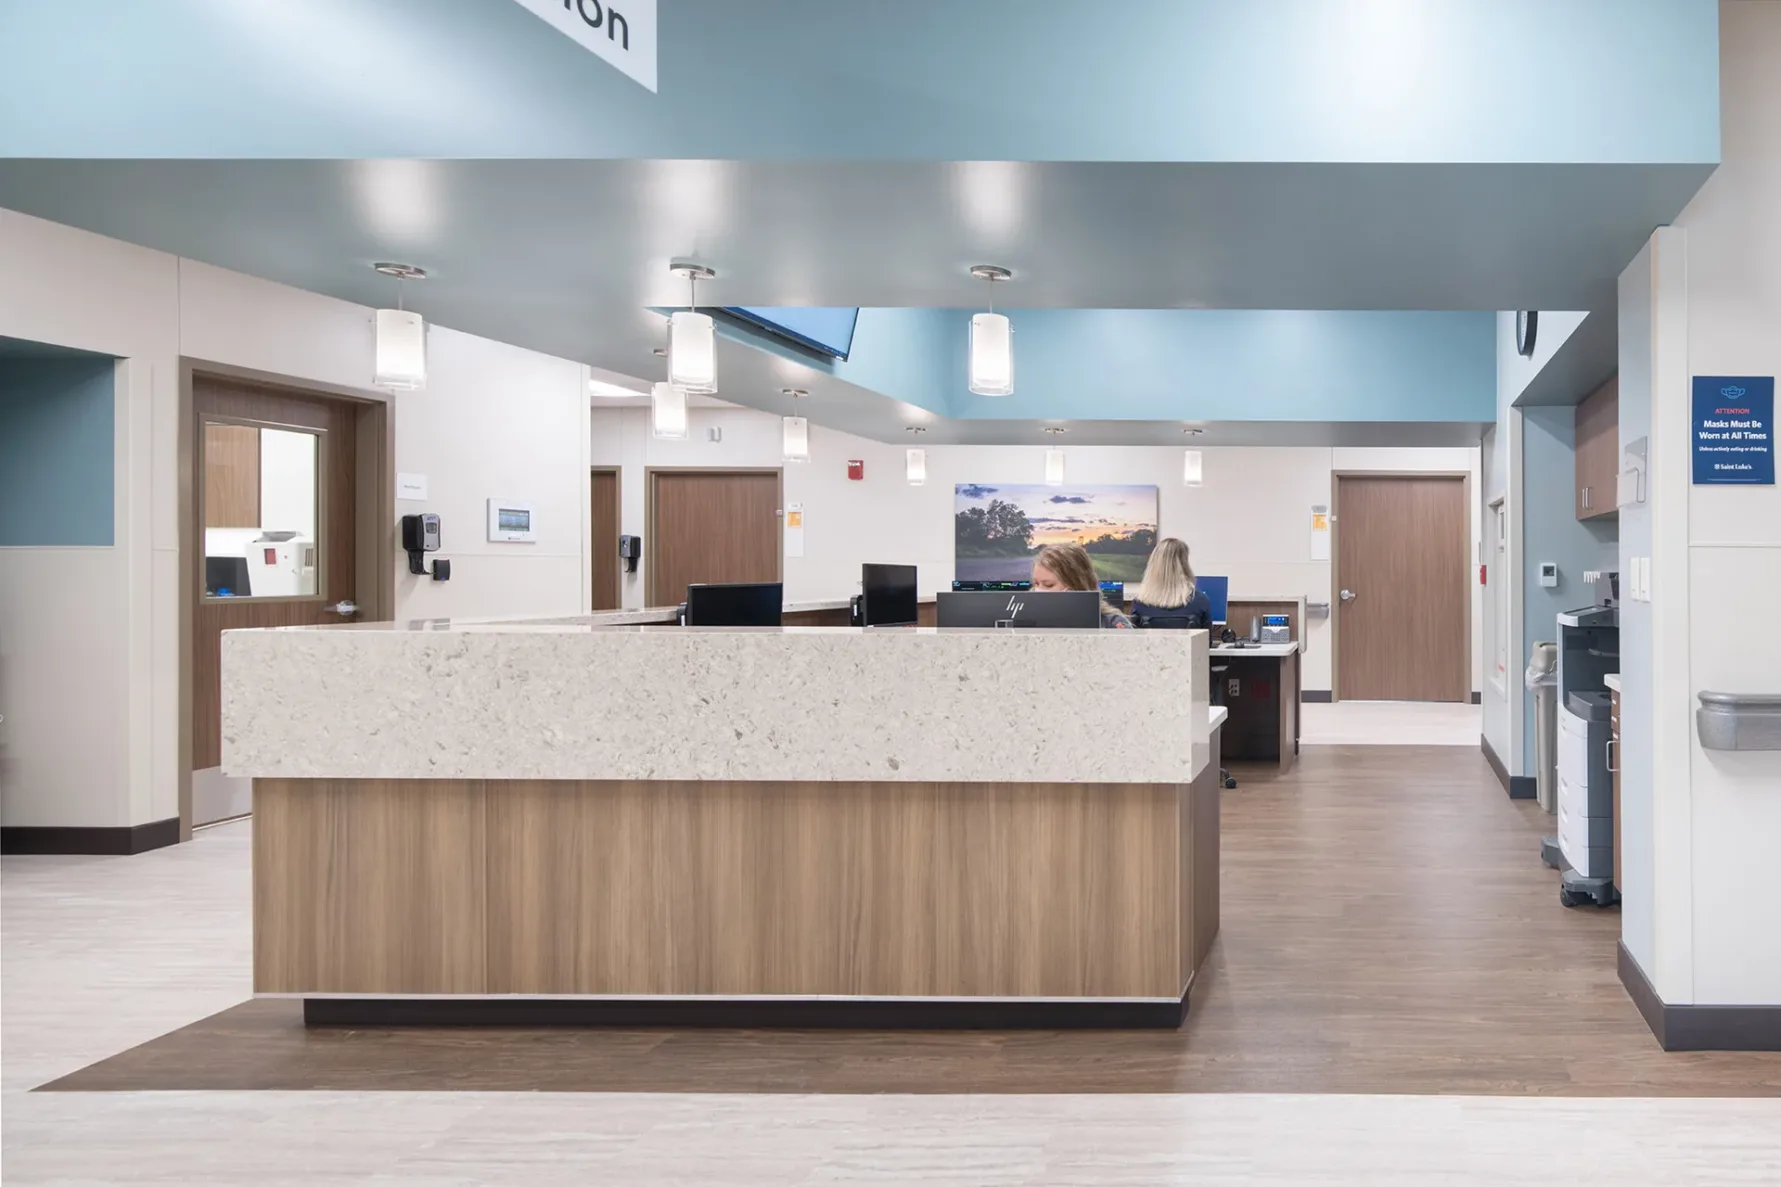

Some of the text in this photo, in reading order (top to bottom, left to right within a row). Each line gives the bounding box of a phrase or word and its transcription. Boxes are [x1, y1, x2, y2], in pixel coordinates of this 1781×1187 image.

[1704, 420, 1762, 428] Masks Must Be
[1699, 432, 1720, 440] Worn
[1731, 432, 1742, 440] All
[1743, 432, 1767, 440] Times
[1006, 595, 1024, 619] hp
